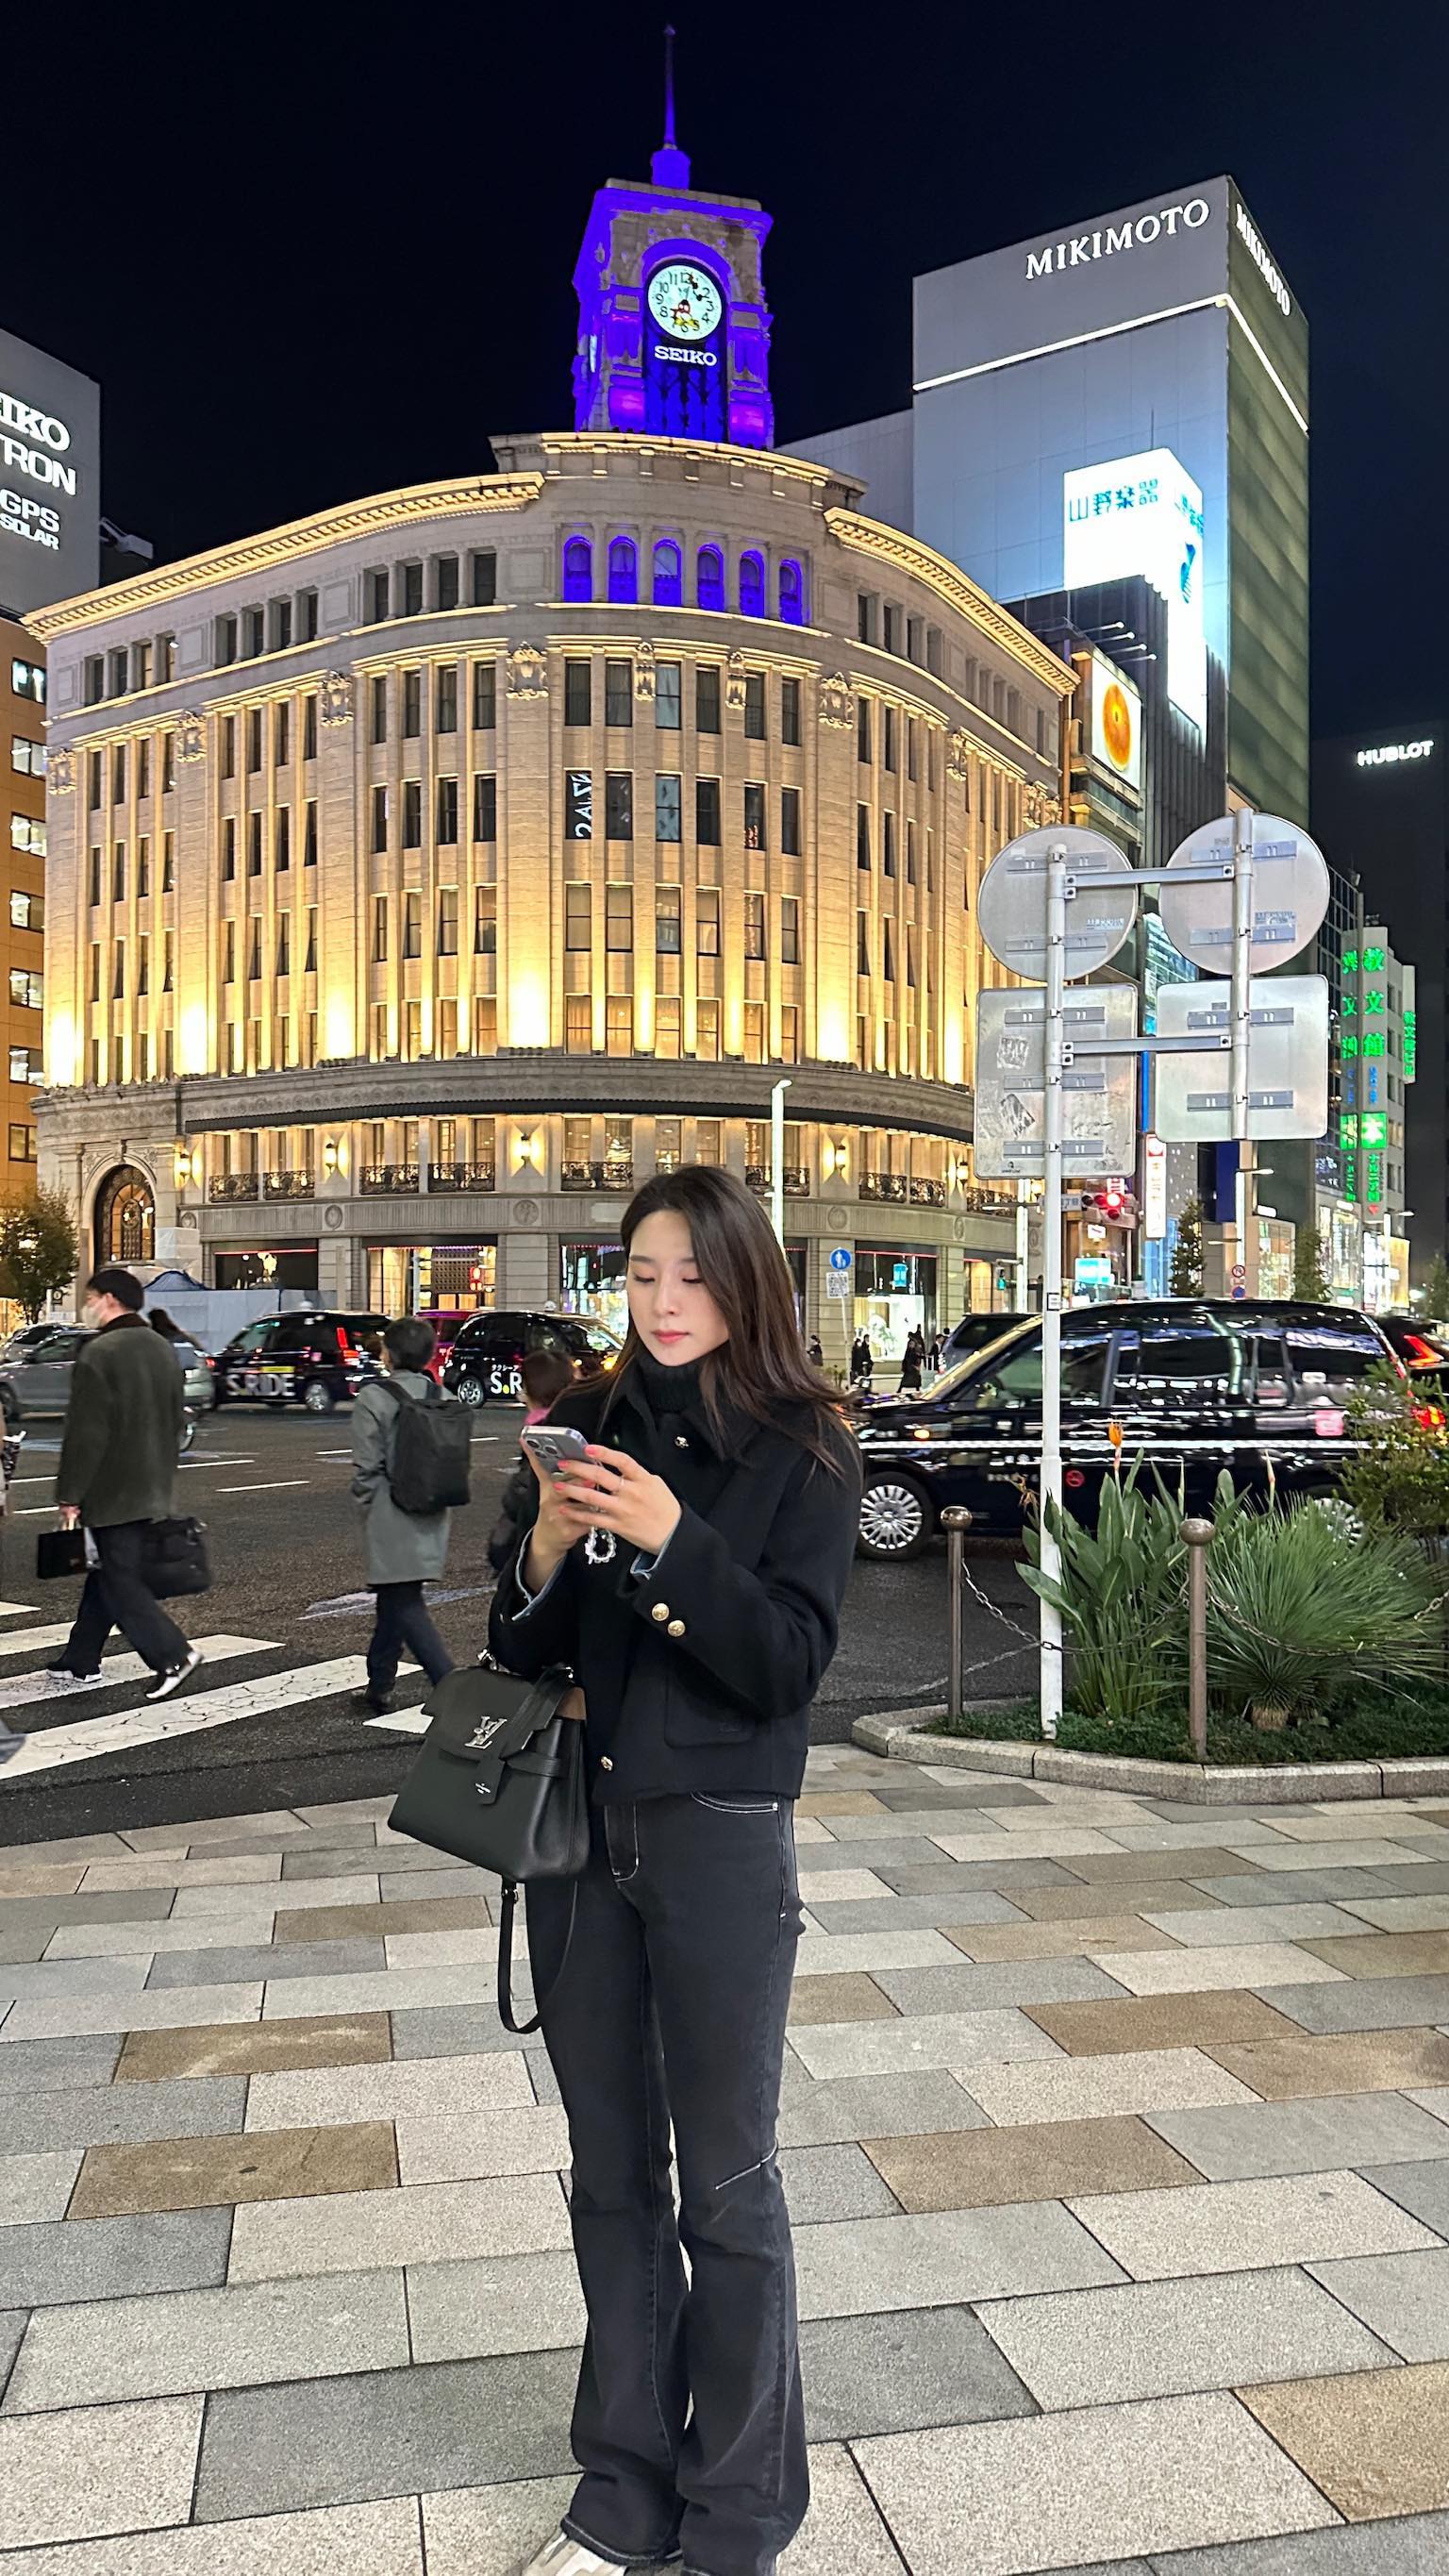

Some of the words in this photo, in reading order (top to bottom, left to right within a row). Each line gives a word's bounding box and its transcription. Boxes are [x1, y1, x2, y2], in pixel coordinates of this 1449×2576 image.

[1025, 198, 1209, 279] MIKIMOTO
[1236, 203, 1291, 316] MIKIMOTO
[656, 293, 664, 305] 9
[660, 306, 668, 318] 8
[707, 300, 715, 312] 3
[654, 345, 717, 366] SEIKO
[0, 392, 71, 451] IKO
[0, 488, 60, 533] GPS
[1069, 478, 1159, 522] 山野楽器
[0, 512, 59, 550] SOLAR
[1357, 740, 1435, 767] HUBLOT
[1362, 947, 1385, 1058] 教文館
[1362, 1115, 1384, 1145] 本
[491, 1371, 524, 1395] S.R
